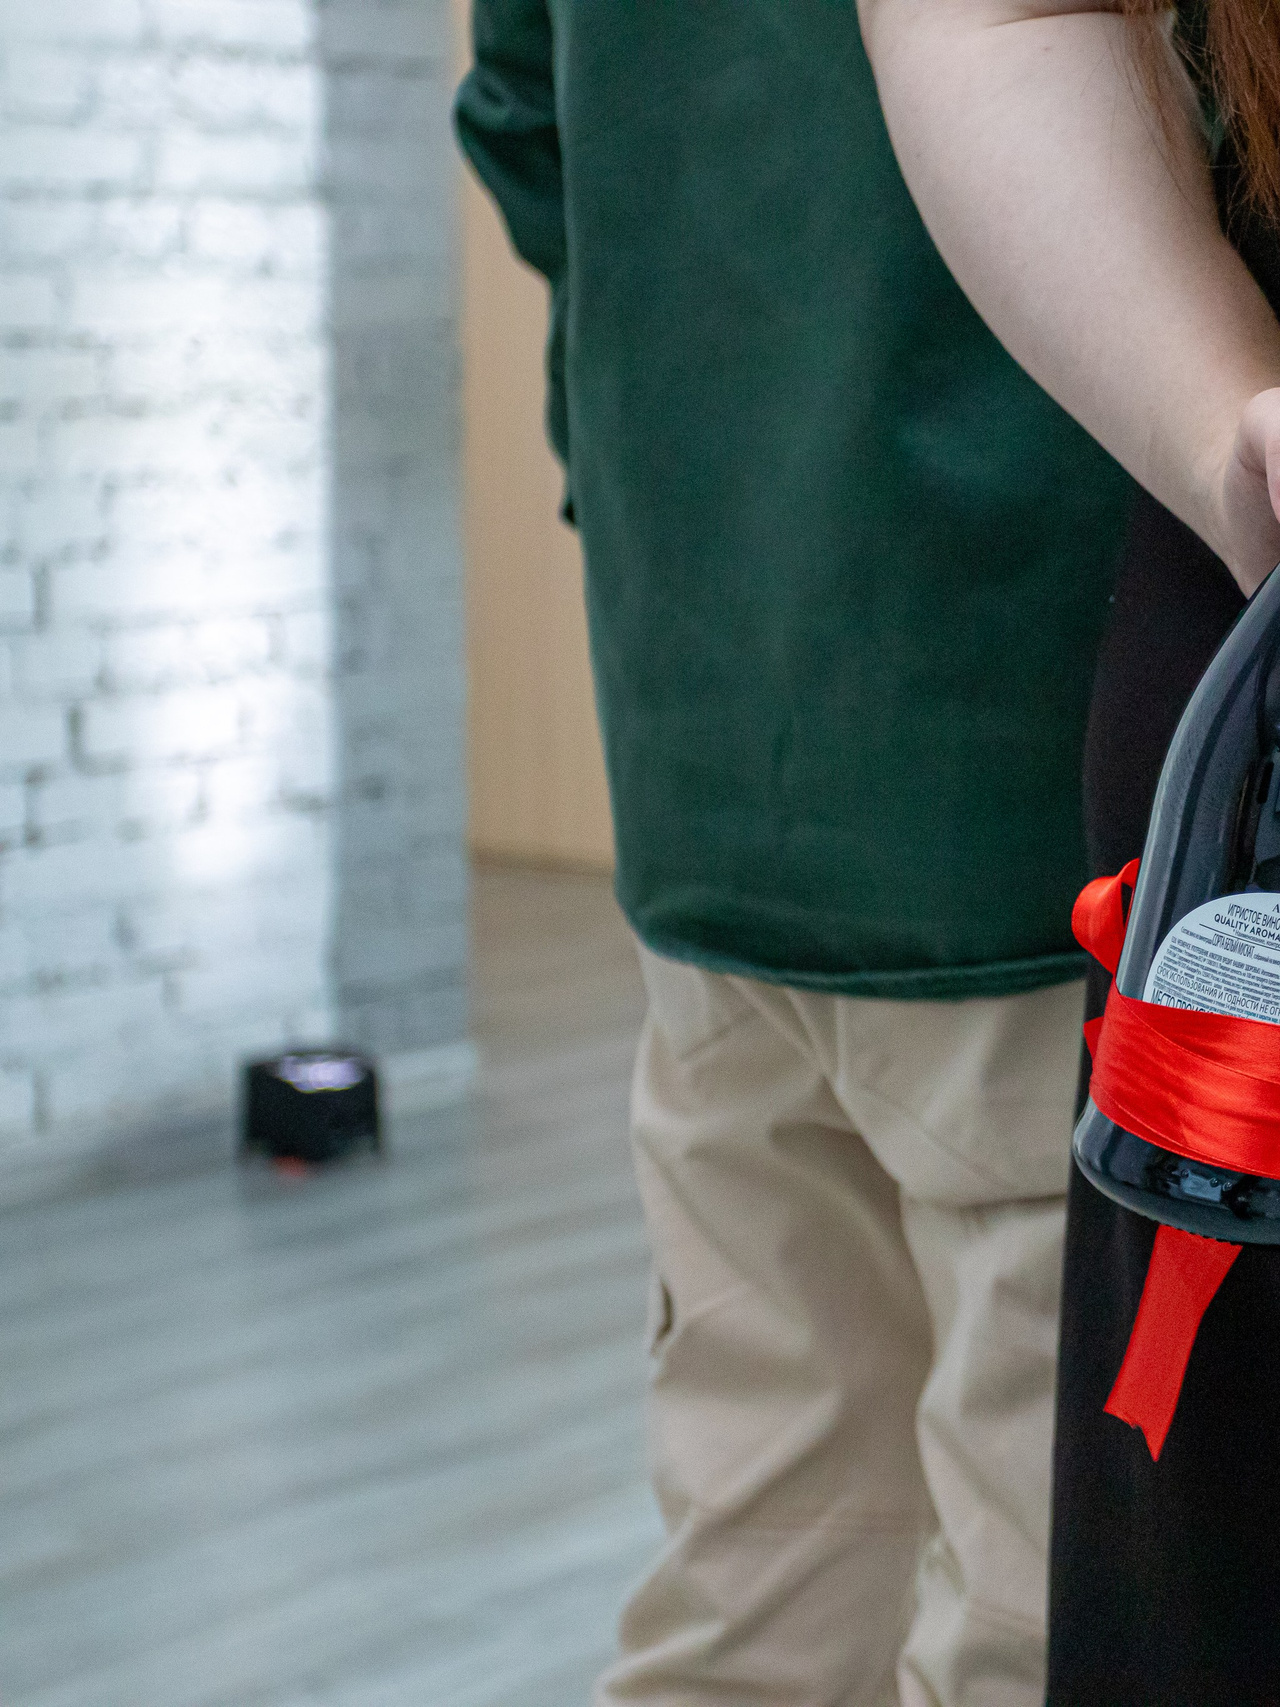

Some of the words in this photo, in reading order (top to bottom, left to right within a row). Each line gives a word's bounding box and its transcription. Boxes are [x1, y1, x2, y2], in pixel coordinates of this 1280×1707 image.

[1214, 913, 1249, 934] QUALITY
[1227, 903, 1262, 925] ИГРИСТОЕ
[1261, 913, 1280, 931] ВИНО
[1169, 971, 1217, 998] ИСПОЛЬЗОВАНИЯ
[1217, 990, 1224, 1000] И
[1223, 992, 1259, 1011] ГОДНОСТИ
[1259, 1002, 1269, 1013] НЕ
